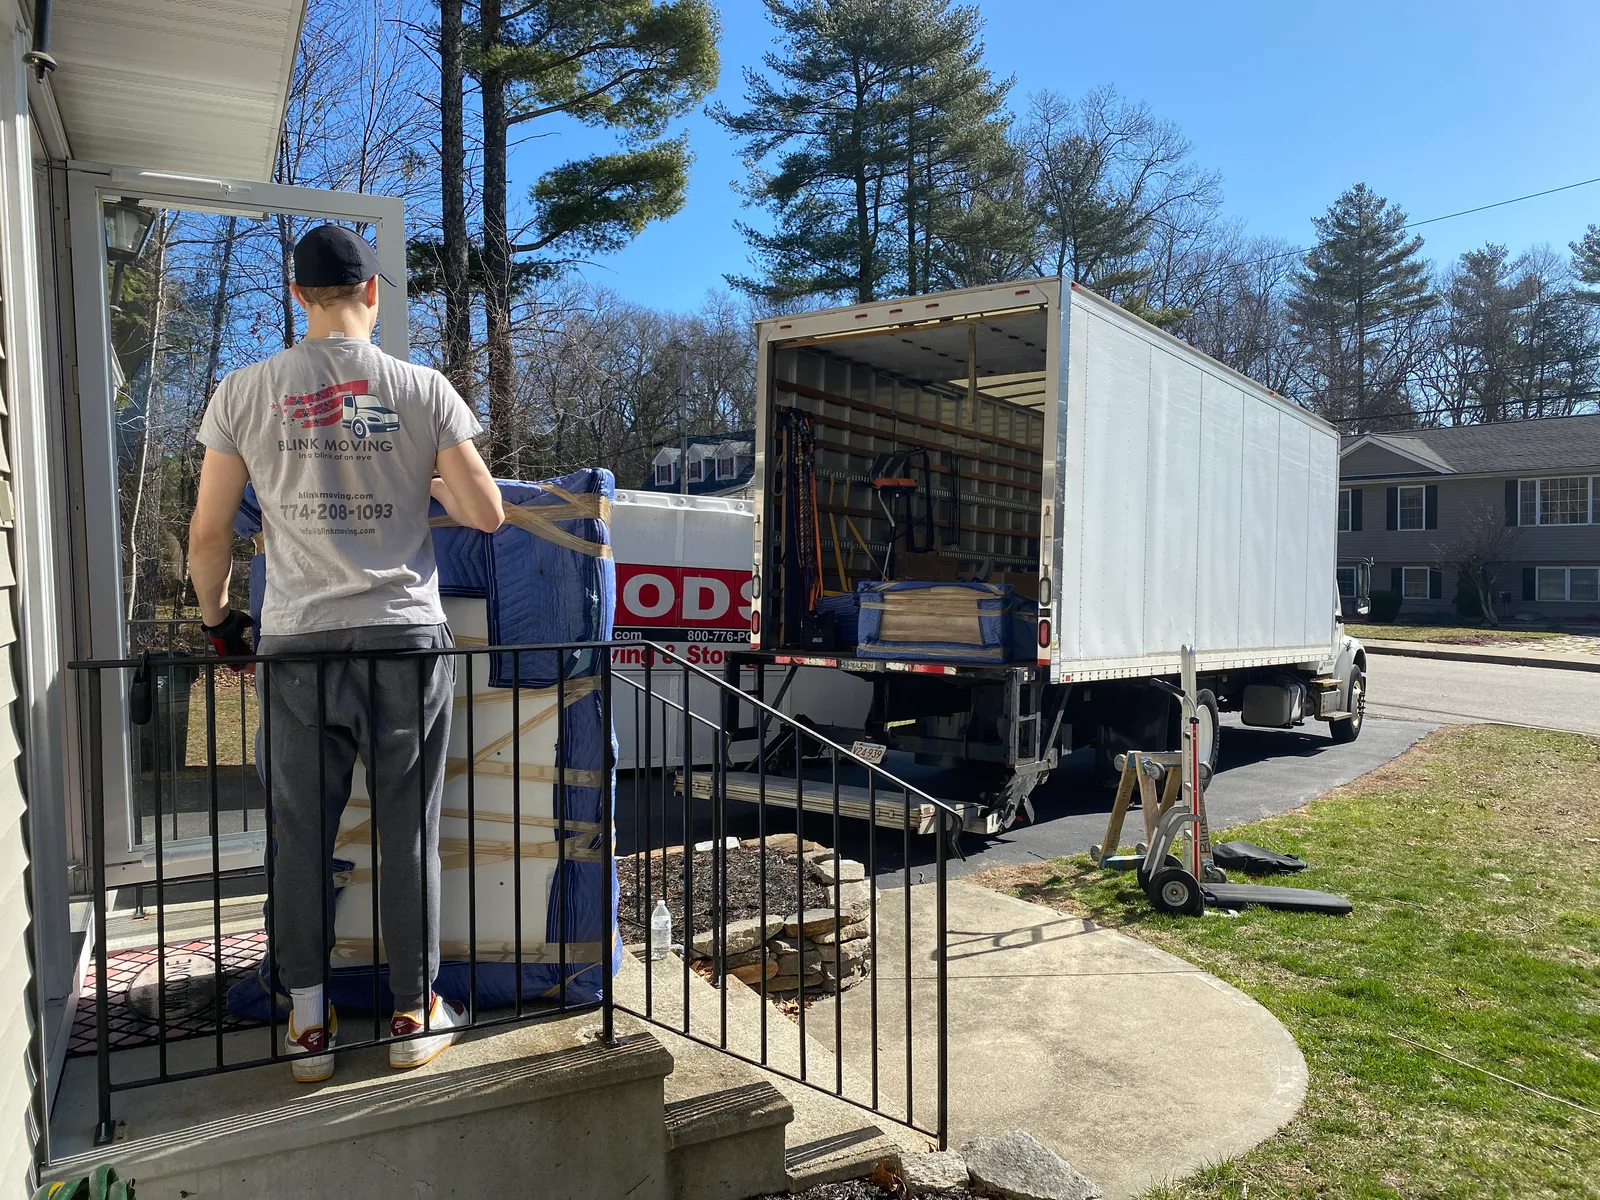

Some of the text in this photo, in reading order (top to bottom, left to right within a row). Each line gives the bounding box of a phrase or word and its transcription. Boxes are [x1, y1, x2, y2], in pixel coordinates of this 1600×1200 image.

[278, 438, 393, 452] BLINK MOVING
[314, 452, 333, 460] blink
[299, 492, 374, 501] blinkmoving.com
[280, 503, 393, 521] 774-208-1093
